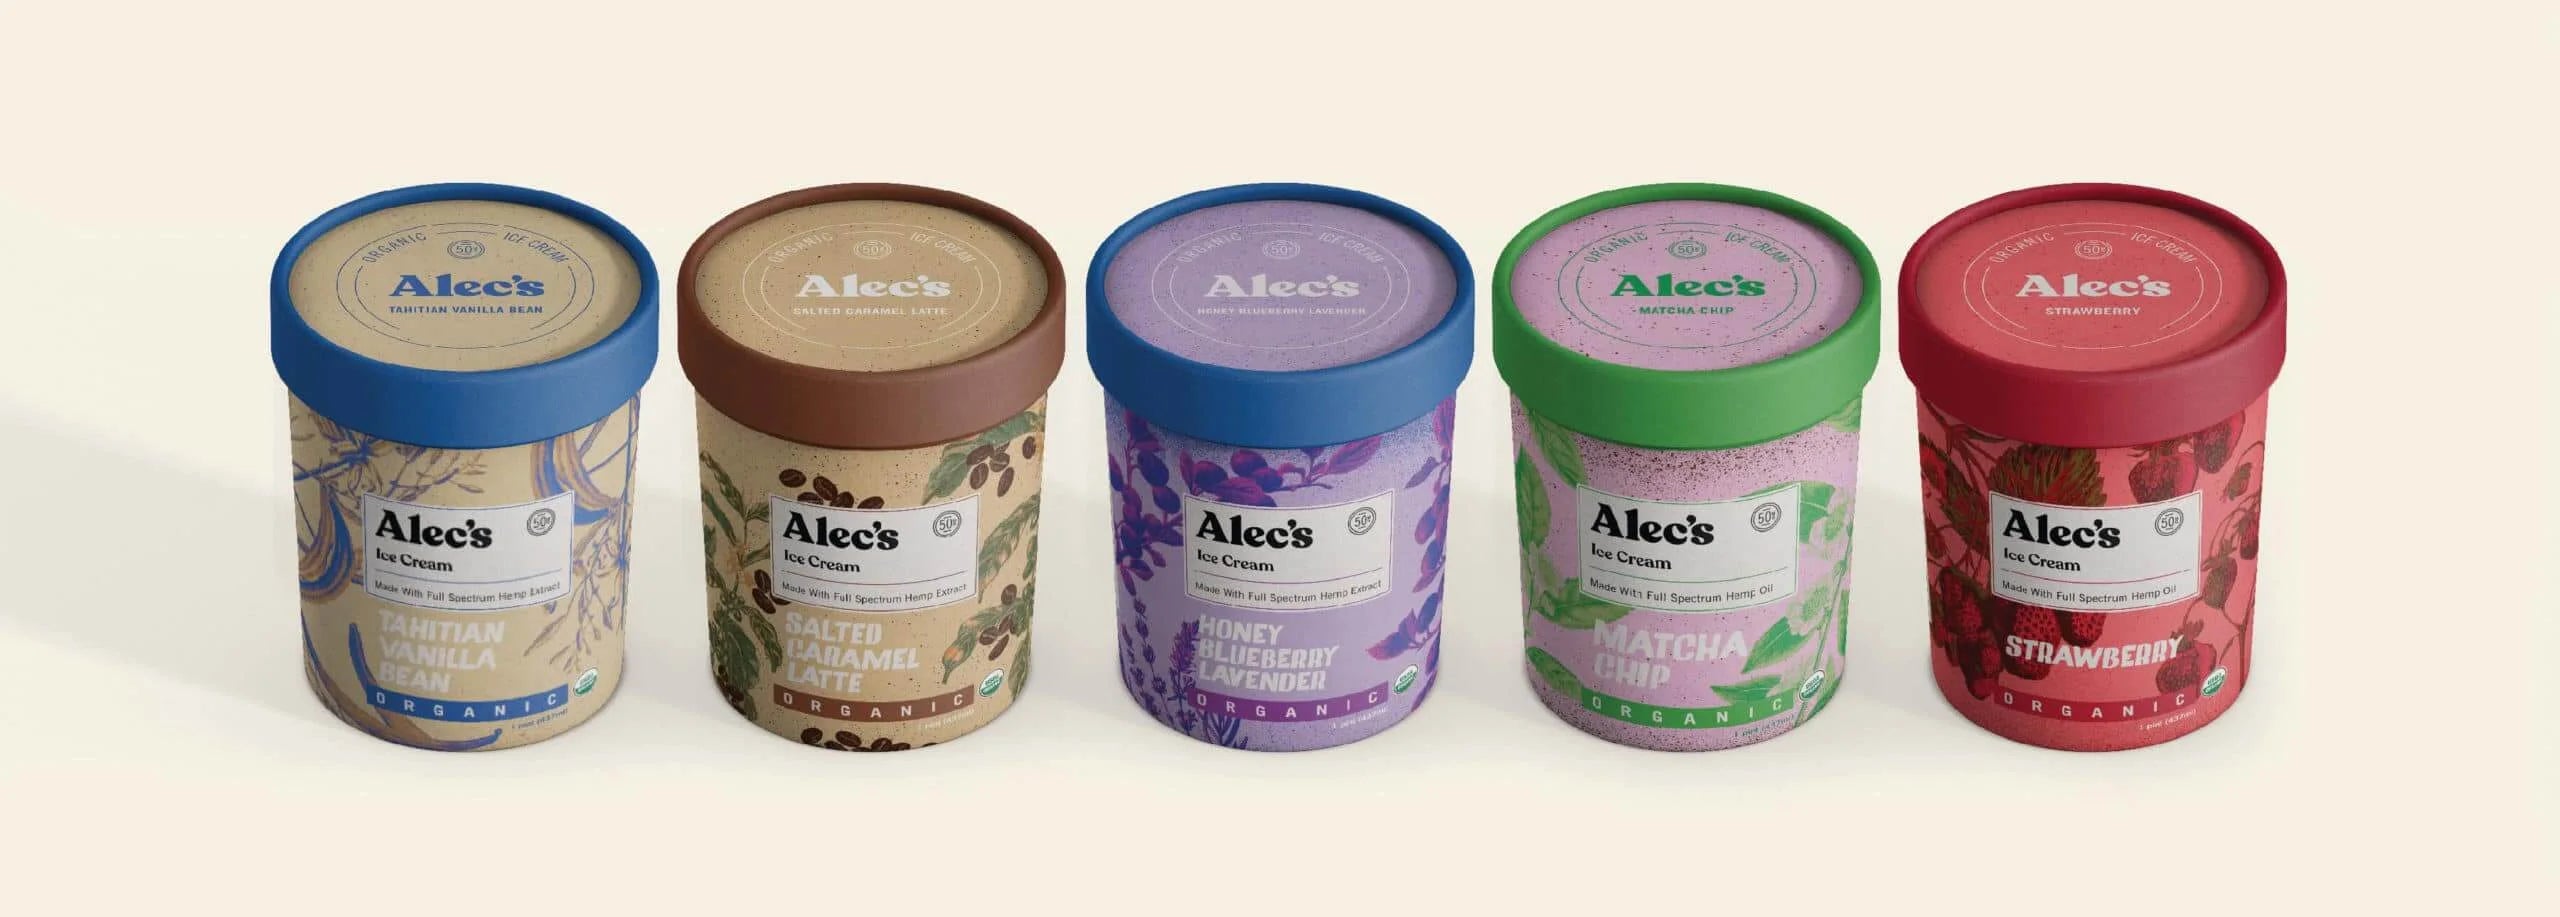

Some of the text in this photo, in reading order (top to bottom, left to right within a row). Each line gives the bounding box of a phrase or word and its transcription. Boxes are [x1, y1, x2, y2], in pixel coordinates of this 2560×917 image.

[363, 232, 426, 263] ORGANIC
[504, 232, 569, 263] ICE CREAM
[769, 232, 833, 263] ORGANIC
[1584, 232, 1648, 262] ORGANIC
[1750, 240, 1791, 263] CREAM
[1990, 232, 2054, 263] ORGANIC
[2156, 240, 2196, 263] CREAM
[389, 274, 544, 297] Alec's
[795, 274, 950, 297] Alec's
[1204, 274, 1360, 297] Alec's
[1610, 273, 1765, 297] Alec's
[2015, 274, 2171, 297] Alec's
[794, 307, 948, 315] SALTED CARAMEL LATTE
[2045, 307, 2141, 315] STRAWBERRY
[376, 509, 492, 548] Alec's
[783, 511, 899, 550] Alec's
[1196, 510, 1313, 549] Alec's
[1591, 502, 1714, 545] Alec's
[2003, 508, 2120, 548] Alec's
[376, 548, 453, 571] Ice Cream
[784, 550, 860, 572] Ice Cream
[1198, 550, 1274, 572] Ice Cream
[1592, 543, 1672, 569] Ice Cream
[2004, 548, 2080, 571] Ice Cream
[782, 582, 967, 604] Made With Full Spectrum Hemp Extract
[1196, 580, 1381, 603] Made With Full Spectrum Hemp Extract
[1590, 577, 1773, 604] Made With Full Spectrum Hemp Oil
[2002, 580, 2176, 604] Made With Full Spectrum Hemp Oil
[378, 610, 505, 644] TAHITIAN
[785, 611, 882, 645] SALTED
[1198, 615, 1284, 645] HONEY
[1594, 619, 1747, 661] MATCHA
[381, 636, 496, 671] VANILLA
[787, 638, 920, 671] CARAMEL
[1197, 639, 1339, 669] BLUEBERRY
[2005, 634, 2184, 669] STRAWBERRY
[378, 661, 449, 692] BEAN
[787, 661, 863, 693] LATTE
[1200, 663, 1326, 692] LAVENDER
[1594, 652, 1670, 689] CHIP
[377, 692, 556, 718] ORGANIC
[784, 693, 963, 718] ORGANIC
[1197, 691, 1378, 718] ORGANIC
[1592, 698, 1781, 725] ORGANIC
[2004, 694, 2184, 718] ORGANIC
